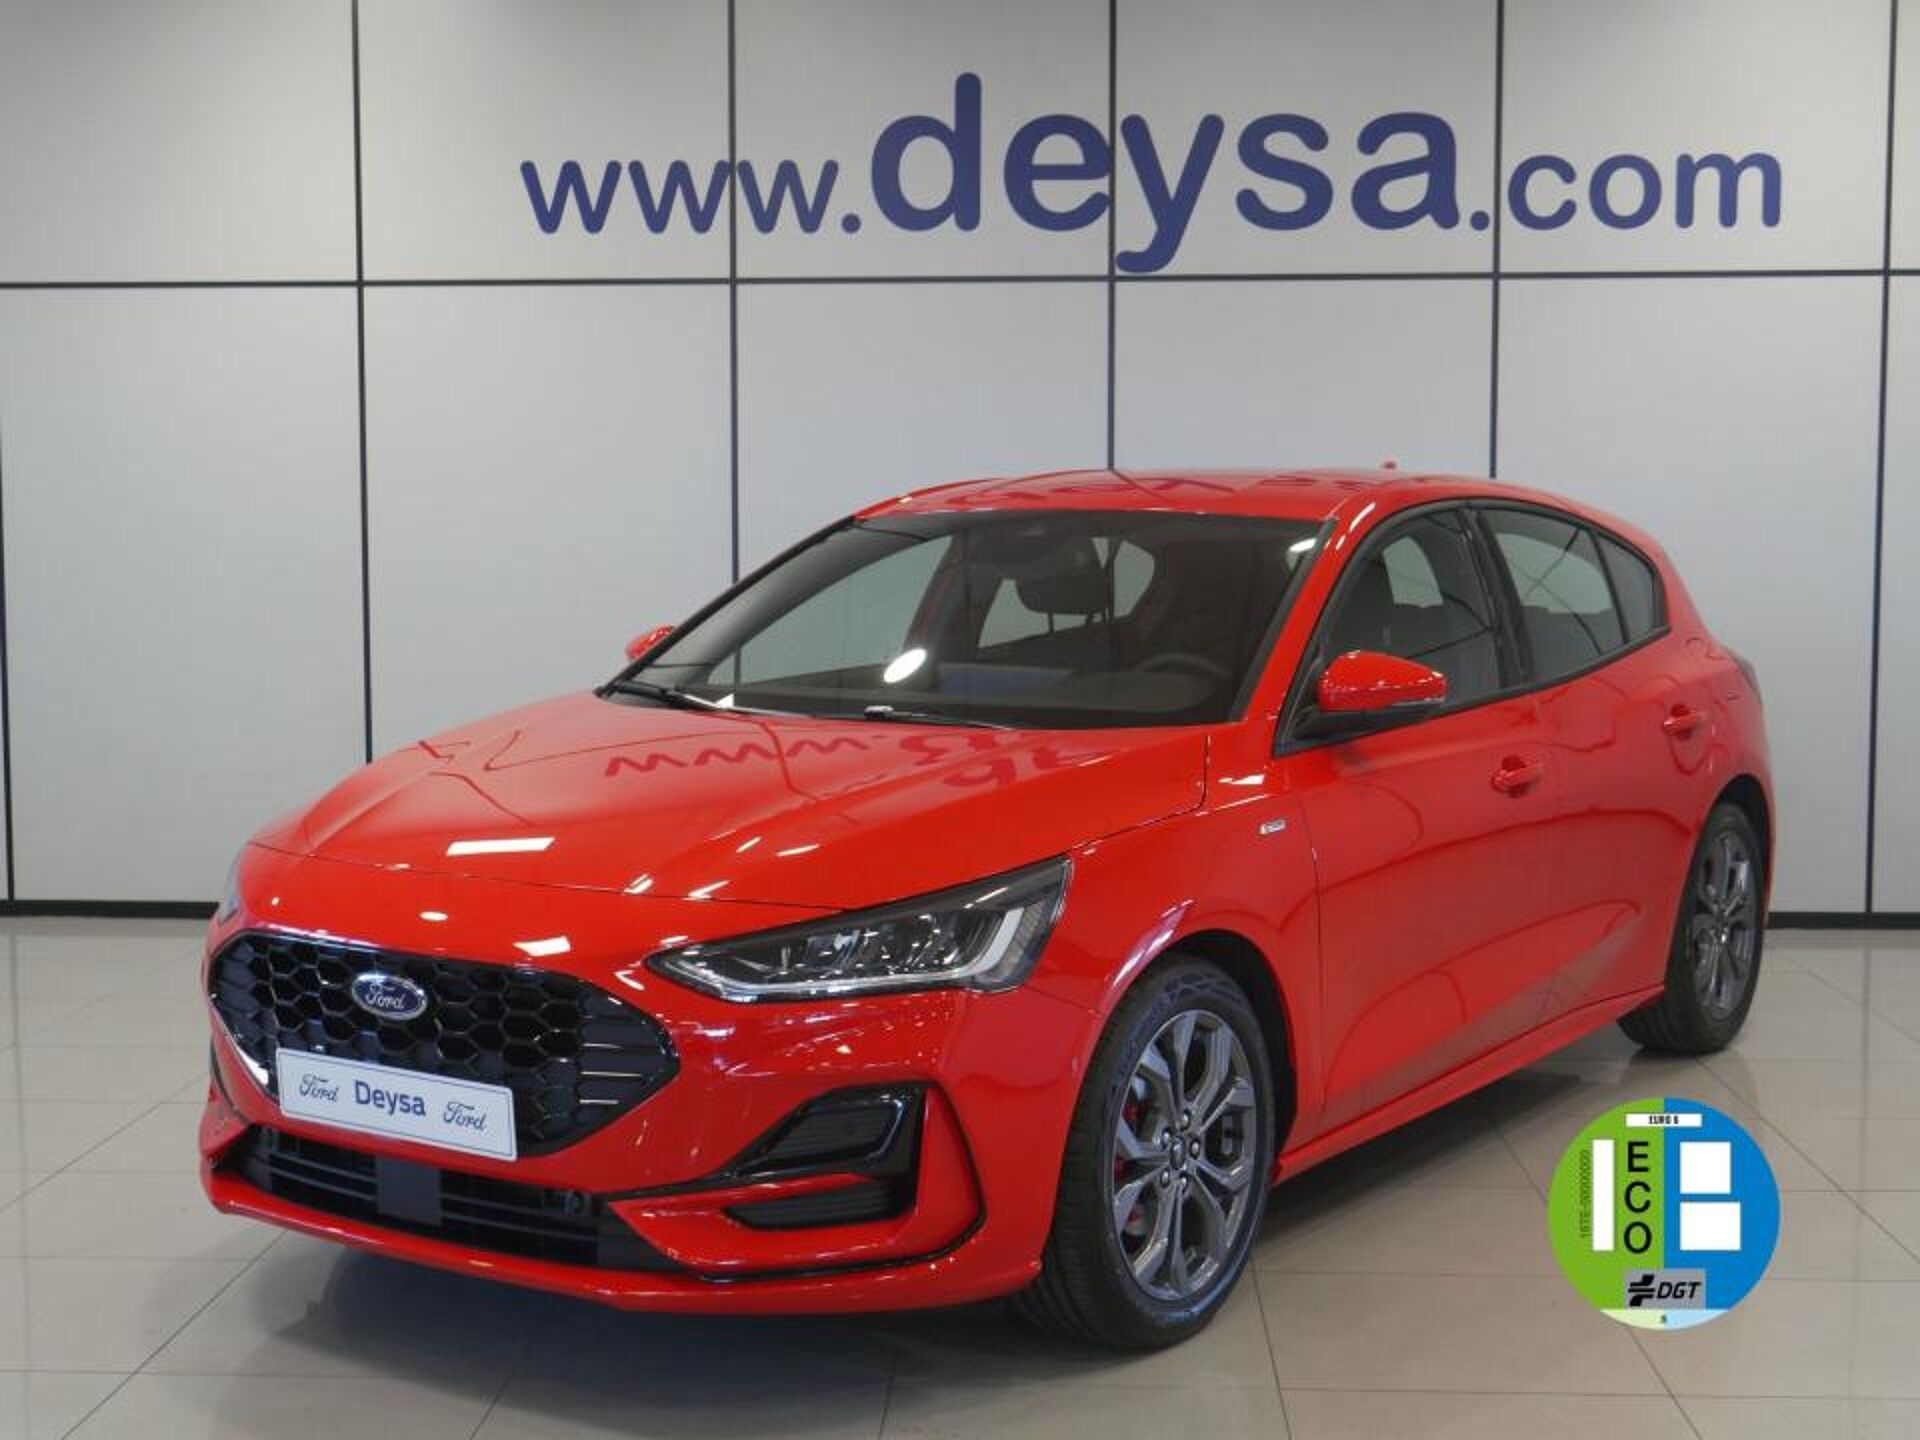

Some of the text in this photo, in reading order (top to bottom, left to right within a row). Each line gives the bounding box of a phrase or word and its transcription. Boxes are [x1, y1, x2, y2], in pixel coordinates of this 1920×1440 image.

[520, 72, 1782, 274] www.deysa.com
[365, 982, 407, 1010] Ford
[298, 1073, 487, 1131] Ford Deysa Ford
